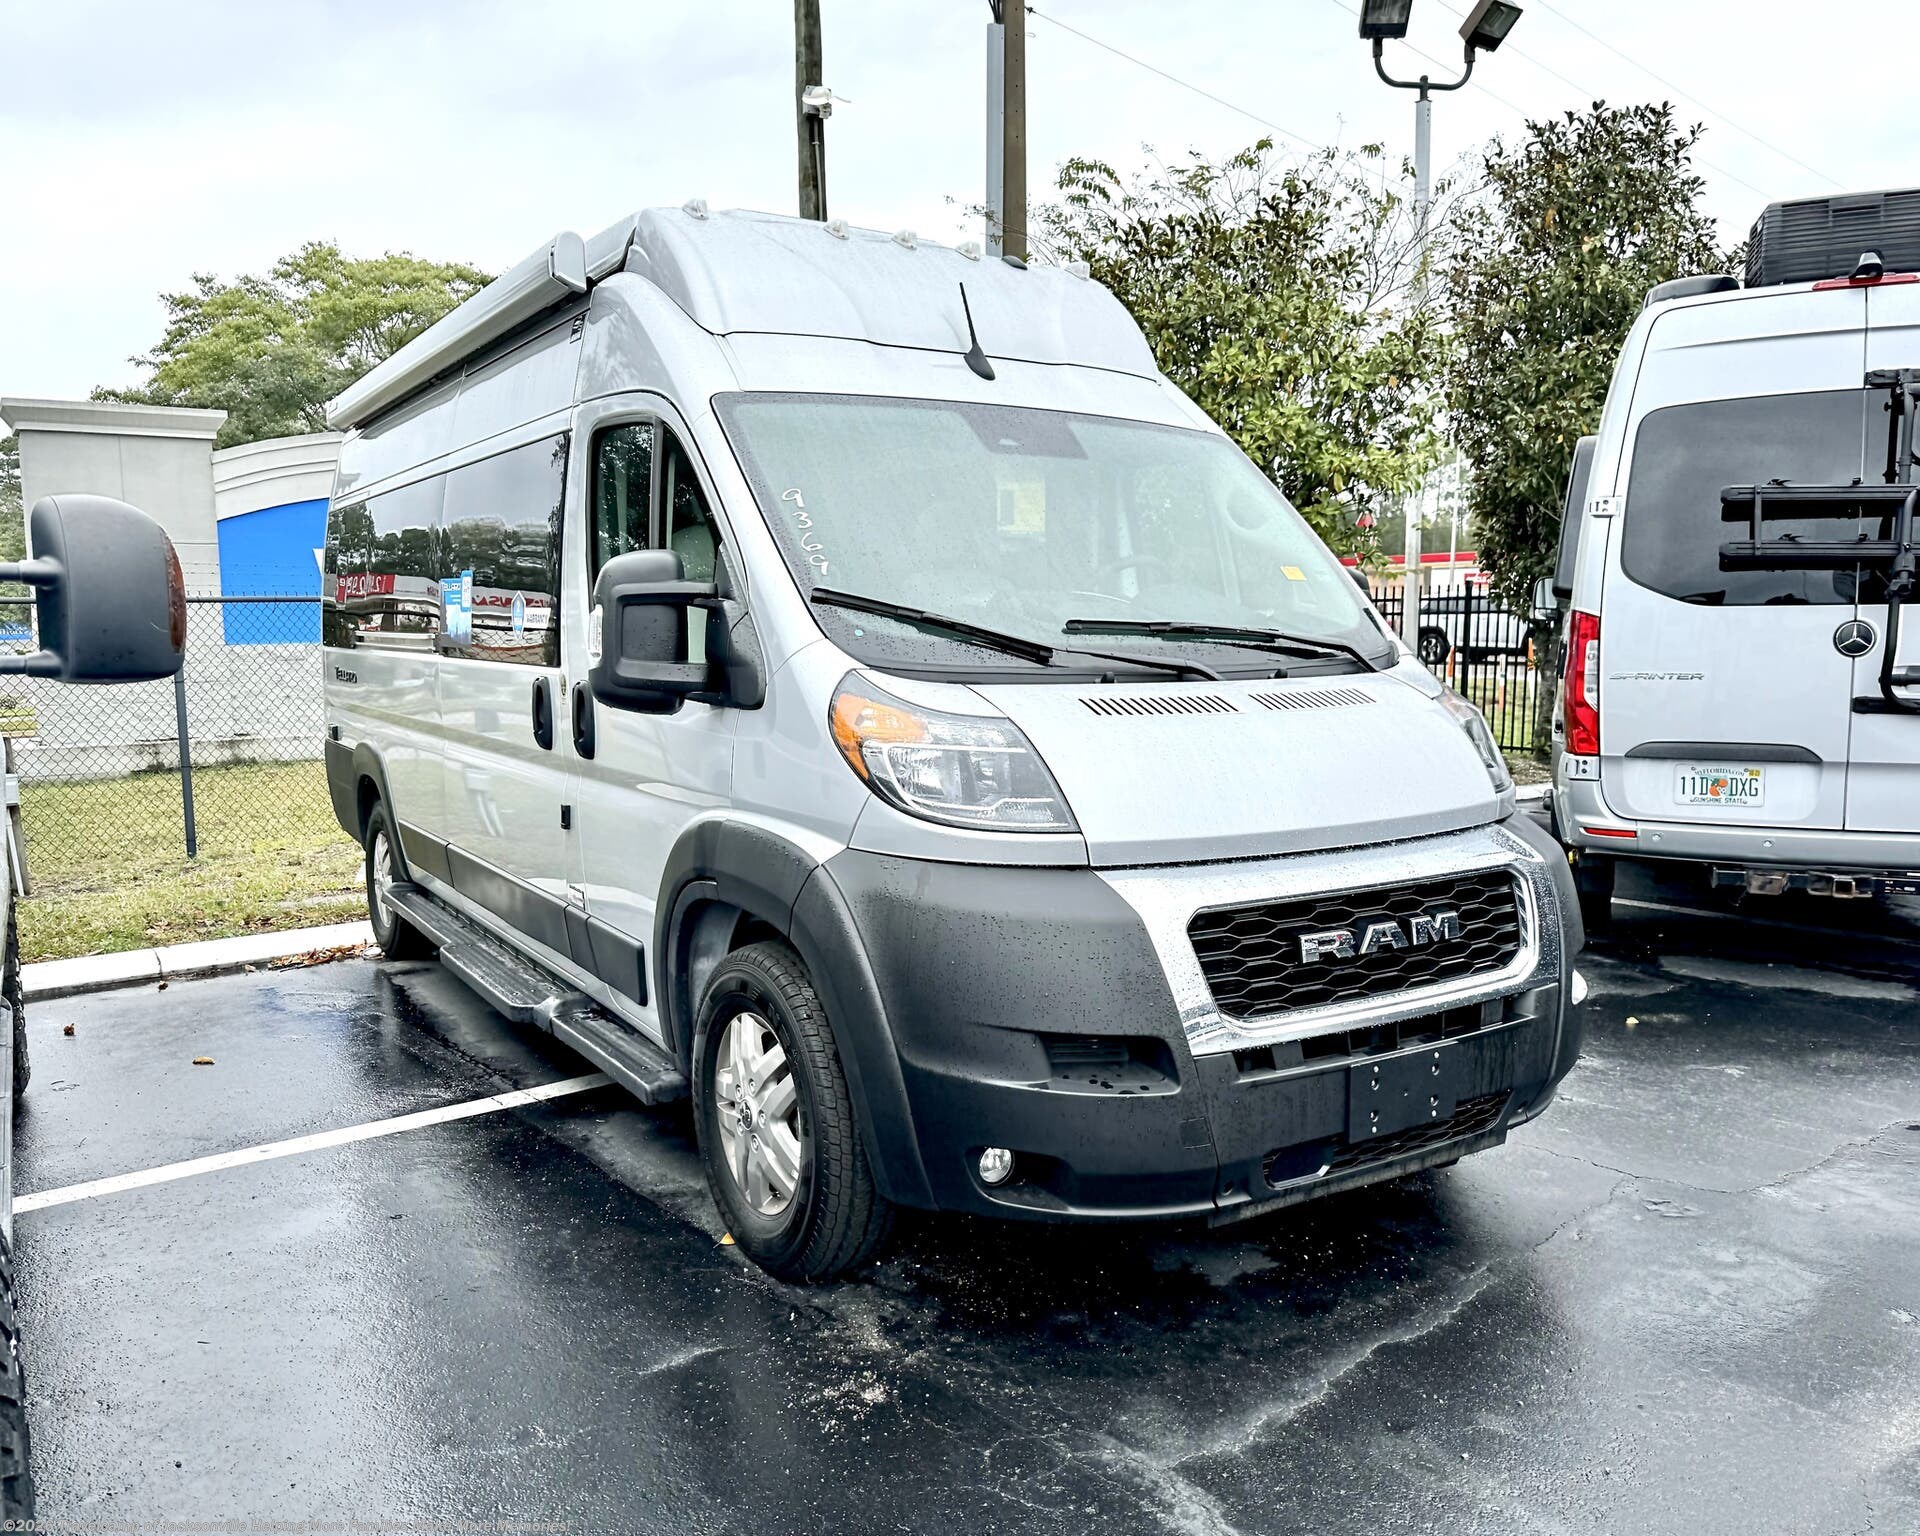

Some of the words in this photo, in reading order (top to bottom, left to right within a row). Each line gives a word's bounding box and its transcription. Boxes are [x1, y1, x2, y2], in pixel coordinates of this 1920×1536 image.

[781, 488, 829, 576] 9369
[1609, 672, 1705, 681] SPRINTER
[1729, 777, 1759, 797] DXG
[1299, 910, 1461, 964] RAM
